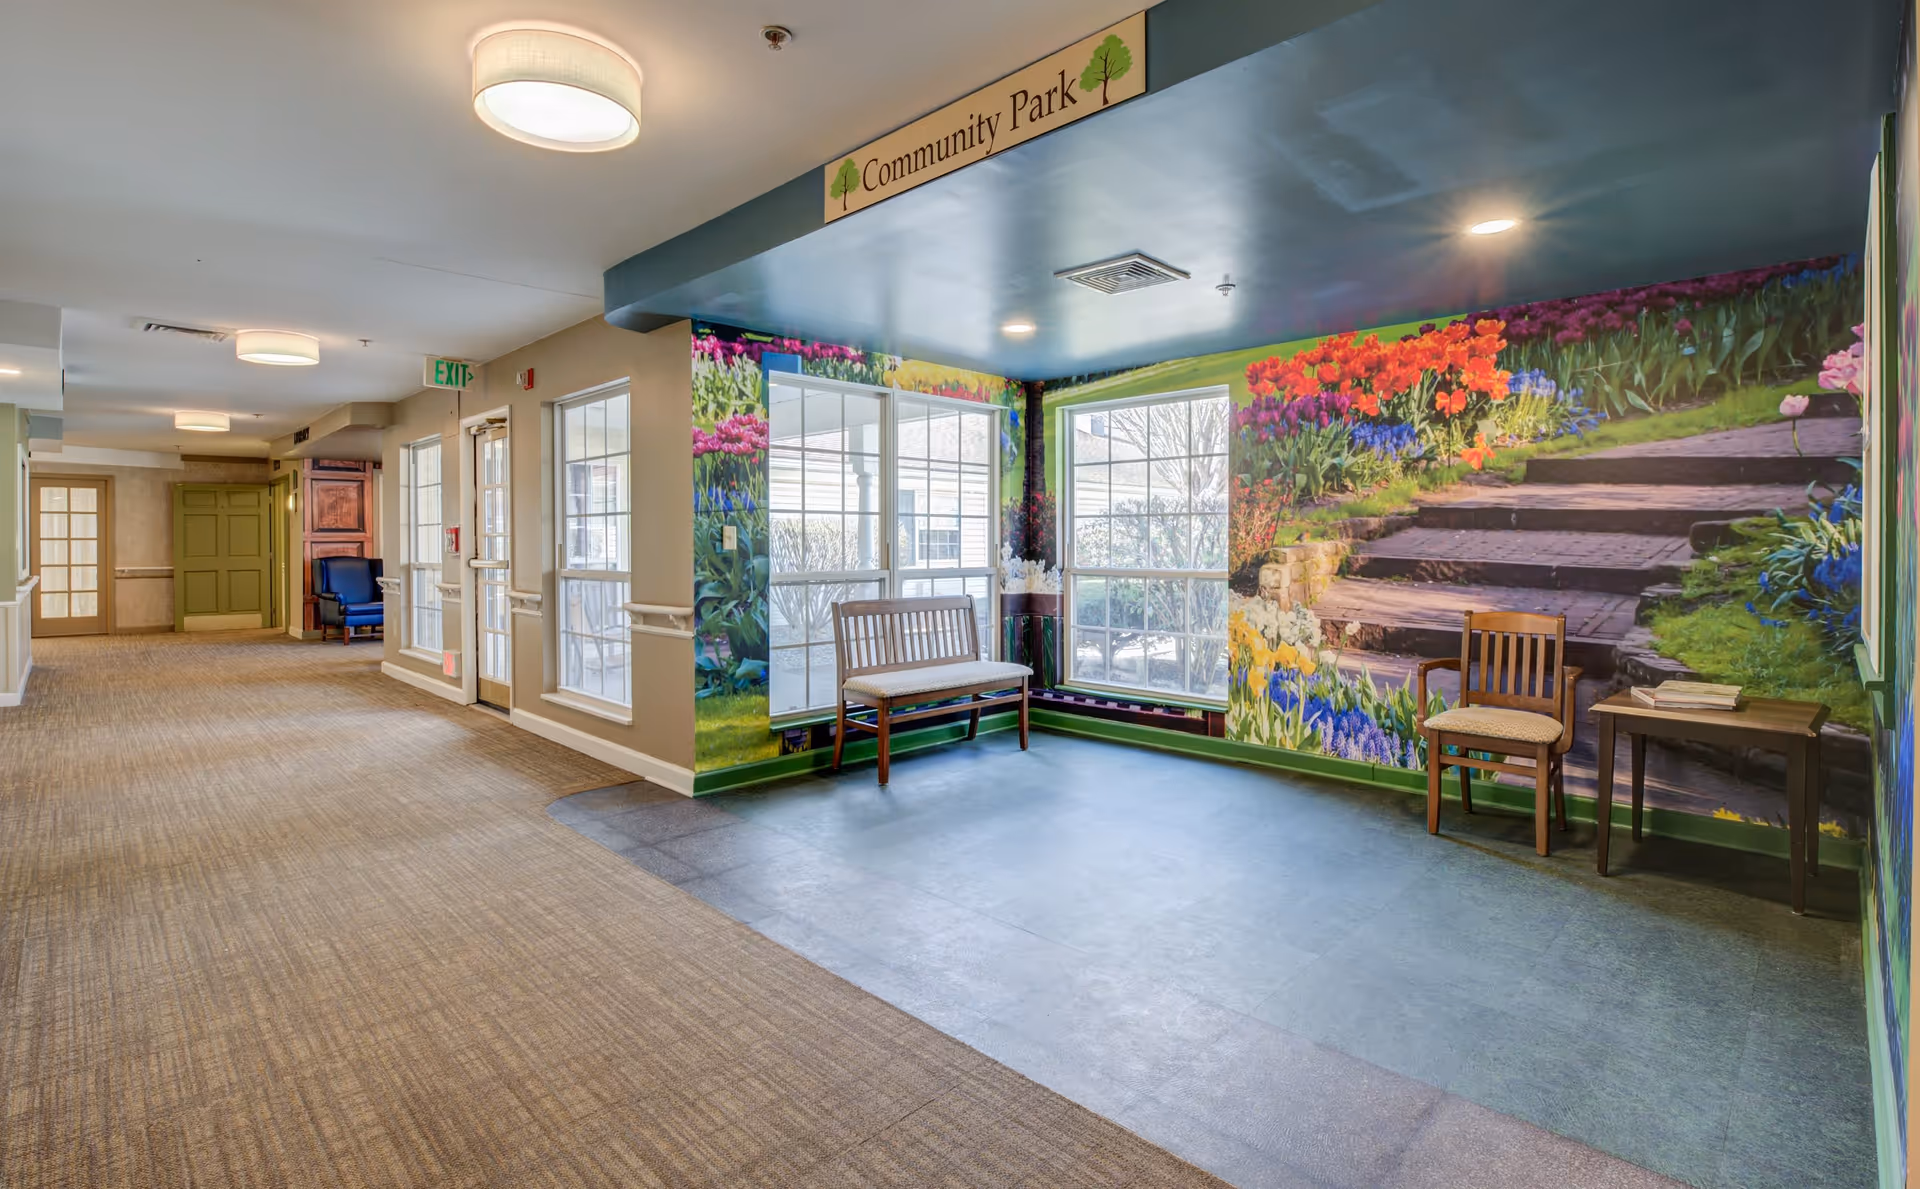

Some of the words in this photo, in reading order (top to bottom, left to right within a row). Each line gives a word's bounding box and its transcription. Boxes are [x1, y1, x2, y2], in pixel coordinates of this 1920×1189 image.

[862, 112, 1001, 192] Community
[1009, 69, 1078, 132] Park
[435, 360, 469, 388] EXIT
